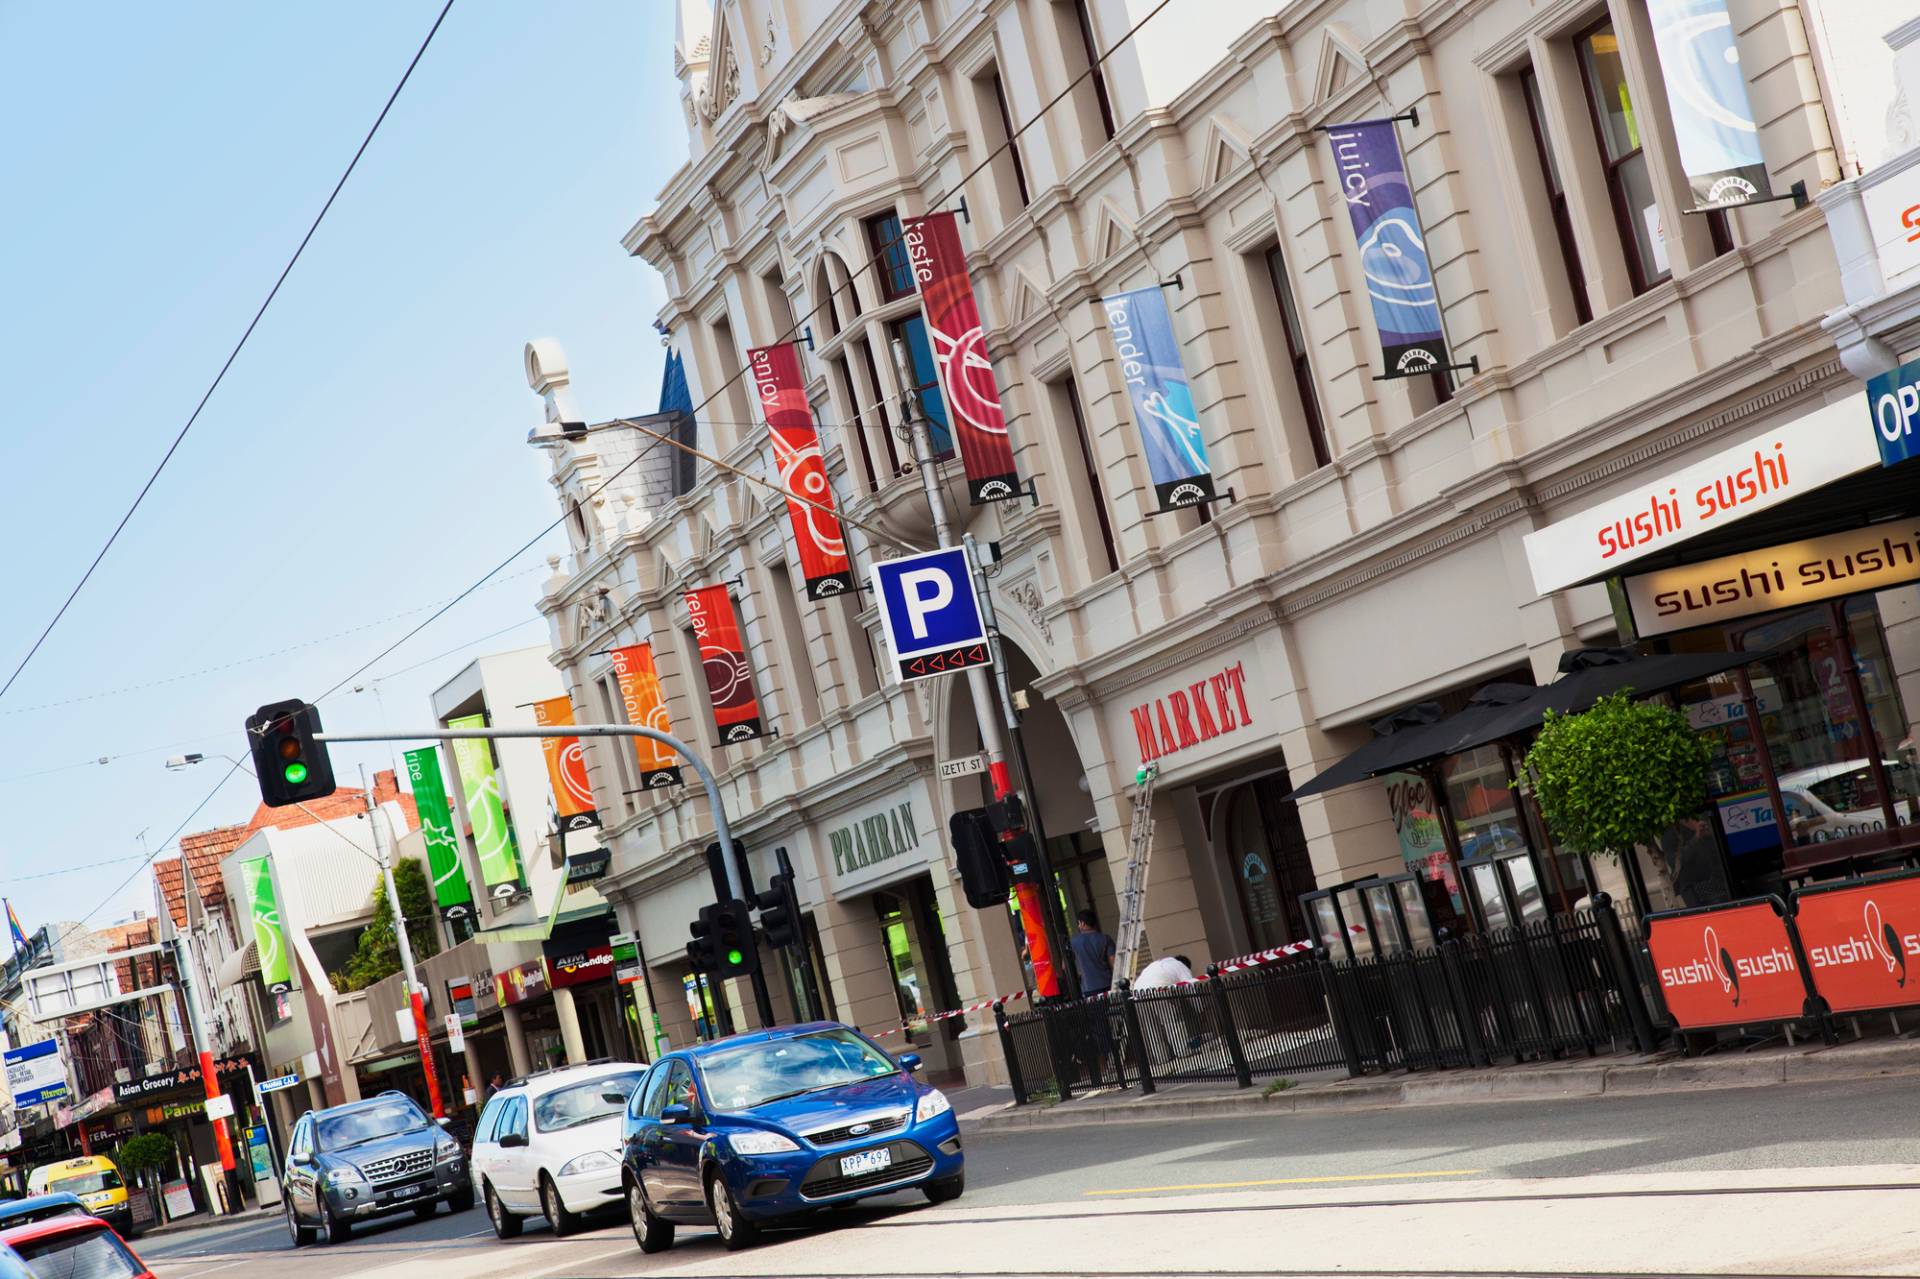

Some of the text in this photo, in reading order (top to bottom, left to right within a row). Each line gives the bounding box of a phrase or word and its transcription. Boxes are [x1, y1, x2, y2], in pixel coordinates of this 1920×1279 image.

[1328, 131, 1371, 208] juicy
[904, 222, 934, 283] taste
[1104, 297, 1146, 388] tender
[1404, 363, 1432, 374] MARKET
[753, 350, 783, 408] enjoy
[1878, 381, 1920, 441] OP
[1598, 442, 1789, 559] sushi sushi
[685, 592, 709, 640] relax
[899, 567, 954, 640] P
[1654, 562, 1784, 617] sushi
[535, 704, 554, 751] relh
[1130, 660, 1253, 763] MARKET
[406, 751, 423, 782] ripe
[941, 759, 981, 776] IZETT ST
[828, 801, 919, 877] PRAHRAN
[1662, 947, 1794, 987] sushi sushi
[1811, 935, 1873, 967] sushi
[119, 1076, 174, 1097] Asian Grocery
